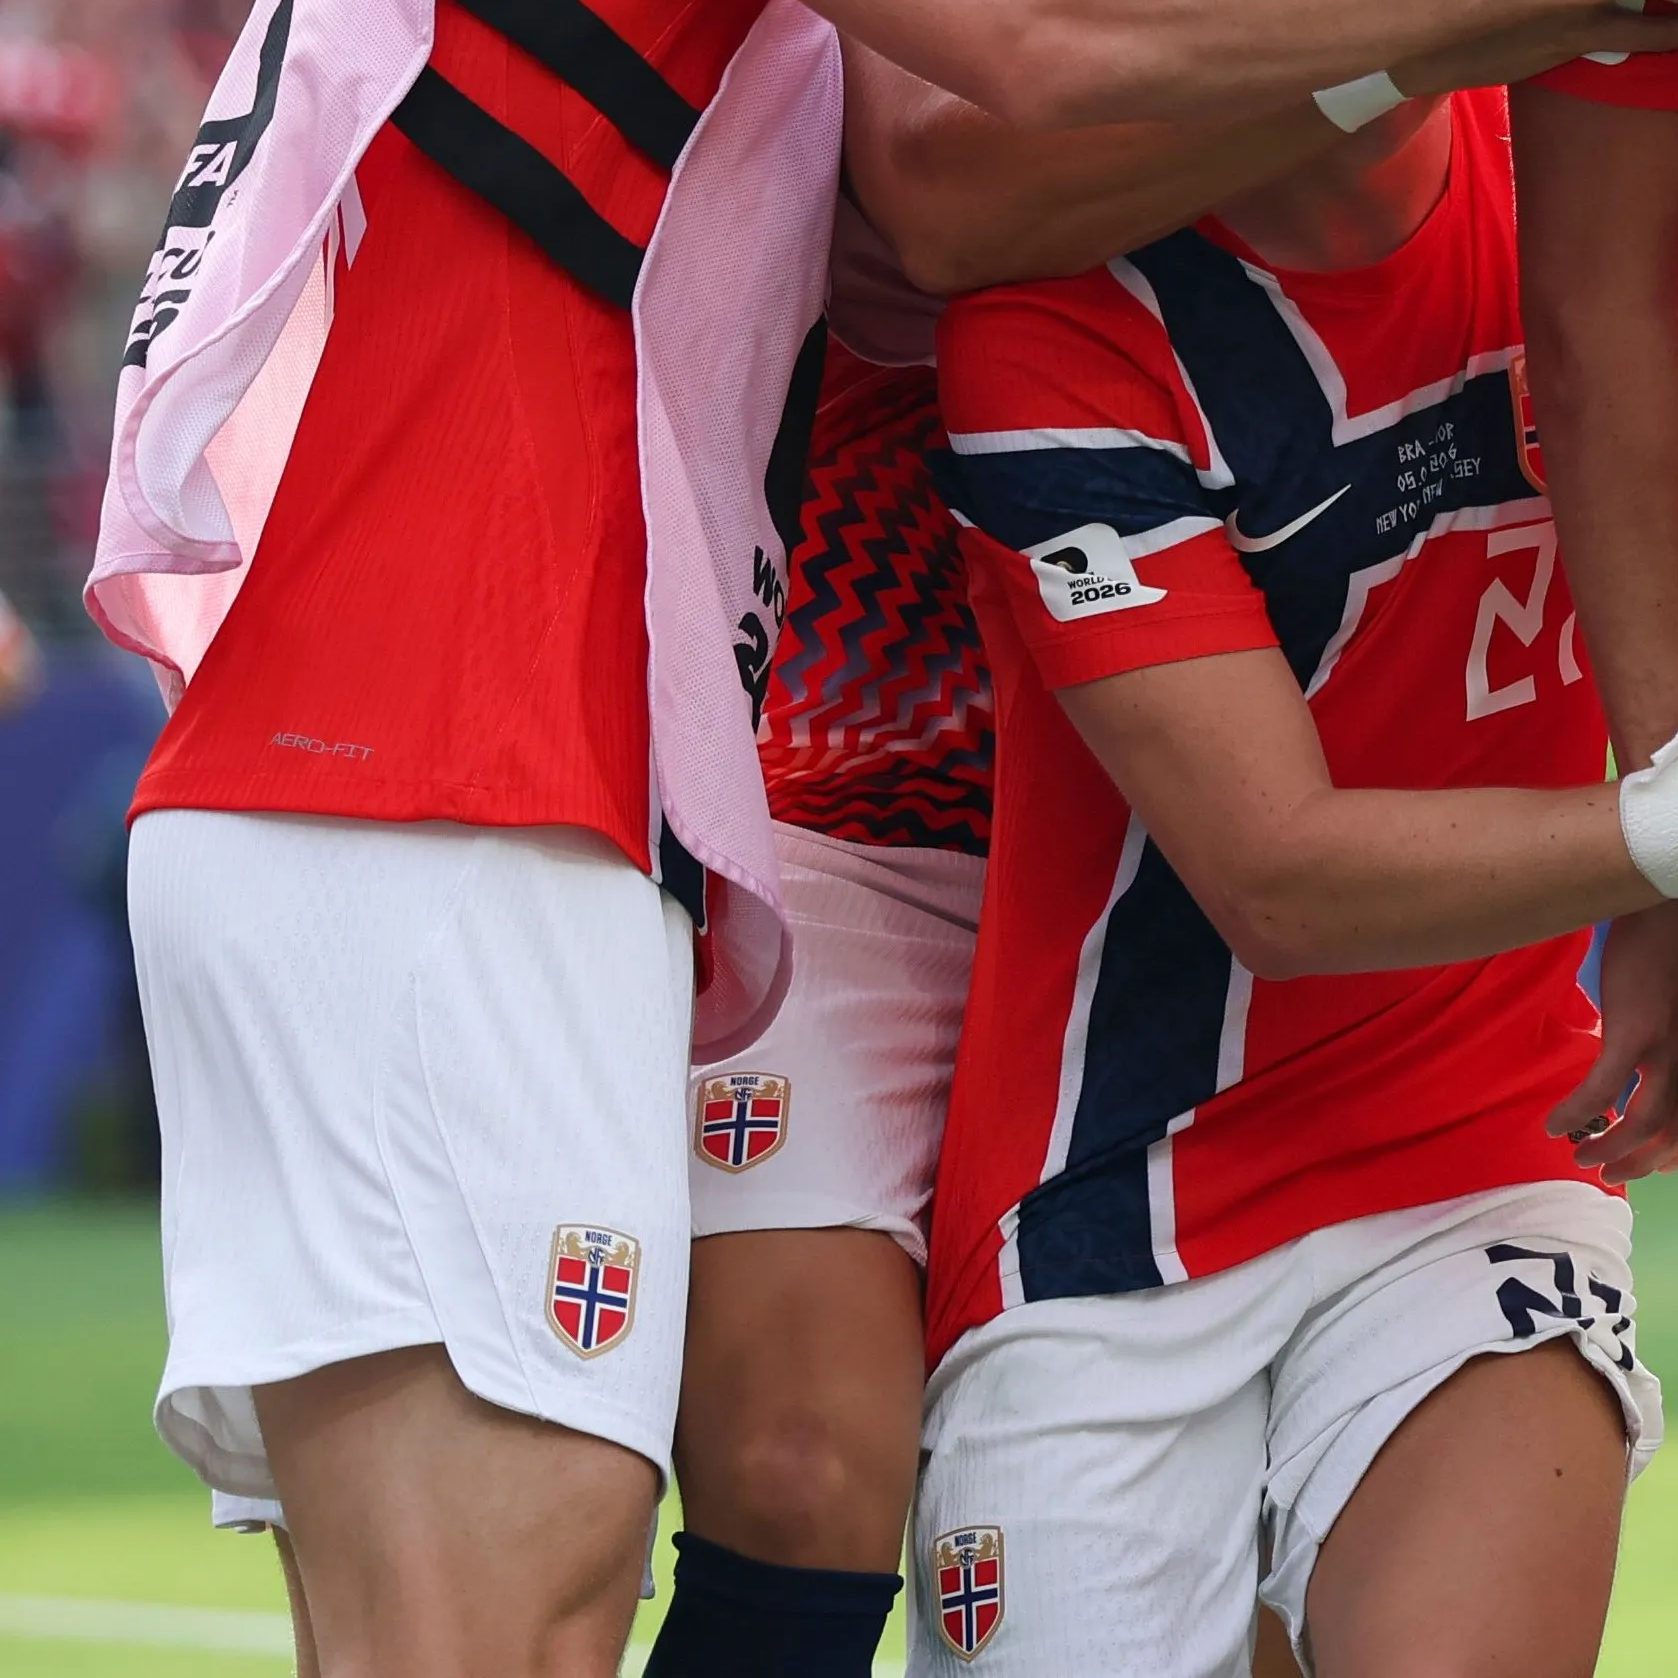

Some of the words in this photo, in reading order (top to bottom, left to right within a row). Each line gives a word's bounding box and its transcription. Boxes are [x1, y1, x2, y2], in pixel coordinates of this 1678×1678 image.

[1398, 440, 1426, 463] BRA
[1435, 423, 1454, 443] OR
[1376, 509, 1397, 535] NEW
[1070, 582, 1131, 606] 2026
[270, 732, 375, 761] AERO-FIT
[730, 1076, 760, 1086] NORGE
[585, 1230, 613, 1247] NORGE
